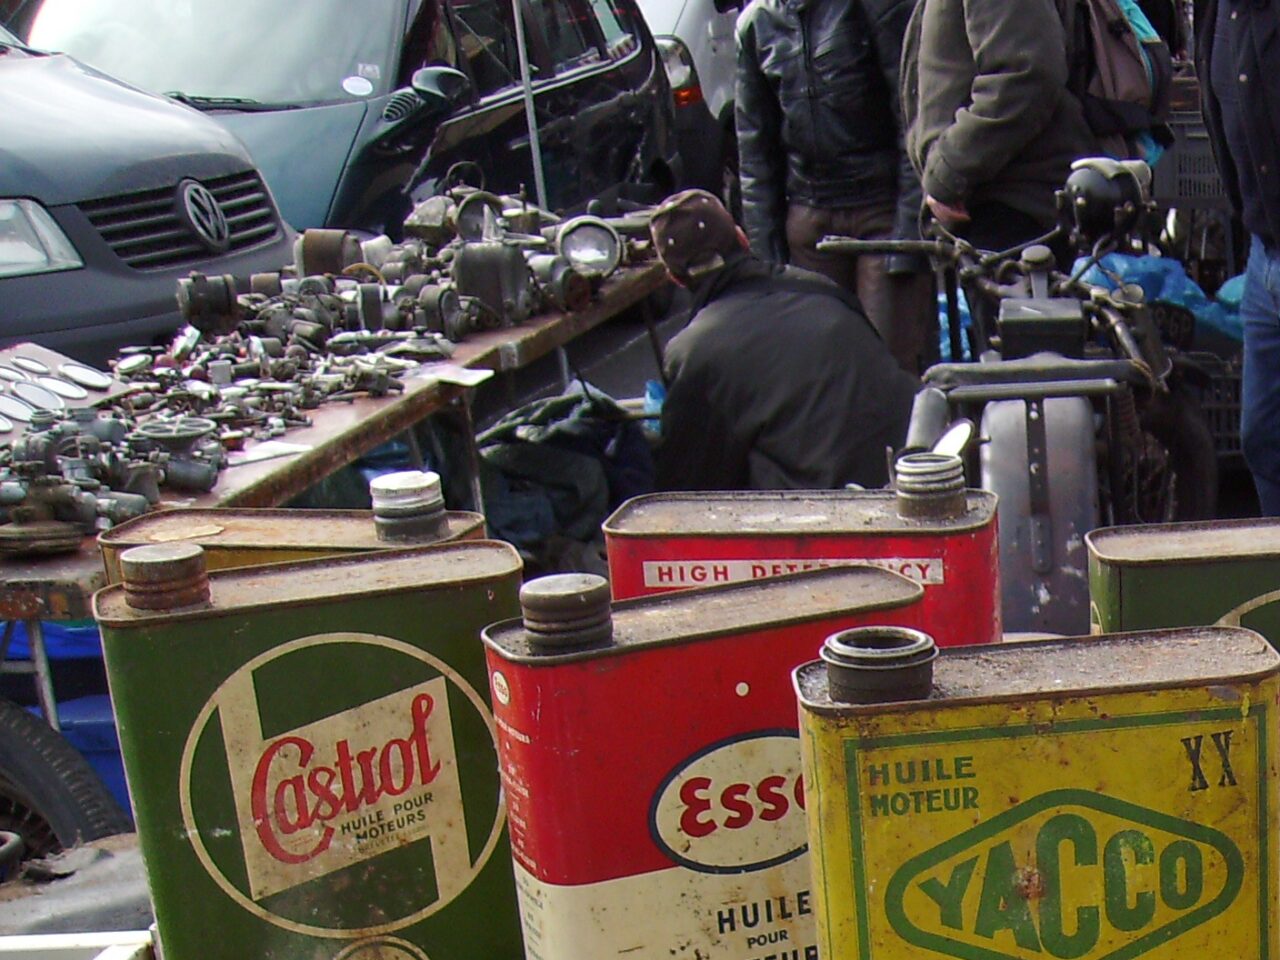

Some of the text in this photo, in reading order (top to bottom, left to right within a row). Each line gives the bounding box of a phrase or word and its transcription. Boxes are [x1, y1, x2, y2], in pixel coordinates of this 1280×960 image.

[656, 565, 729, 583] HIGH
[251, 693, 441, 865] Castrol
[868, 756, 977, 786] HUILE
[341, 791, 433, 835] HUILE POUR
[870, 786, 980, 818] MOTEUR
[354, 809, 426, 844] MOTEURS
[918, 813, 1204, 960] YACCO
[717, 889, 812, 935] HUILE
[747, 929, 790, 950] POUR
